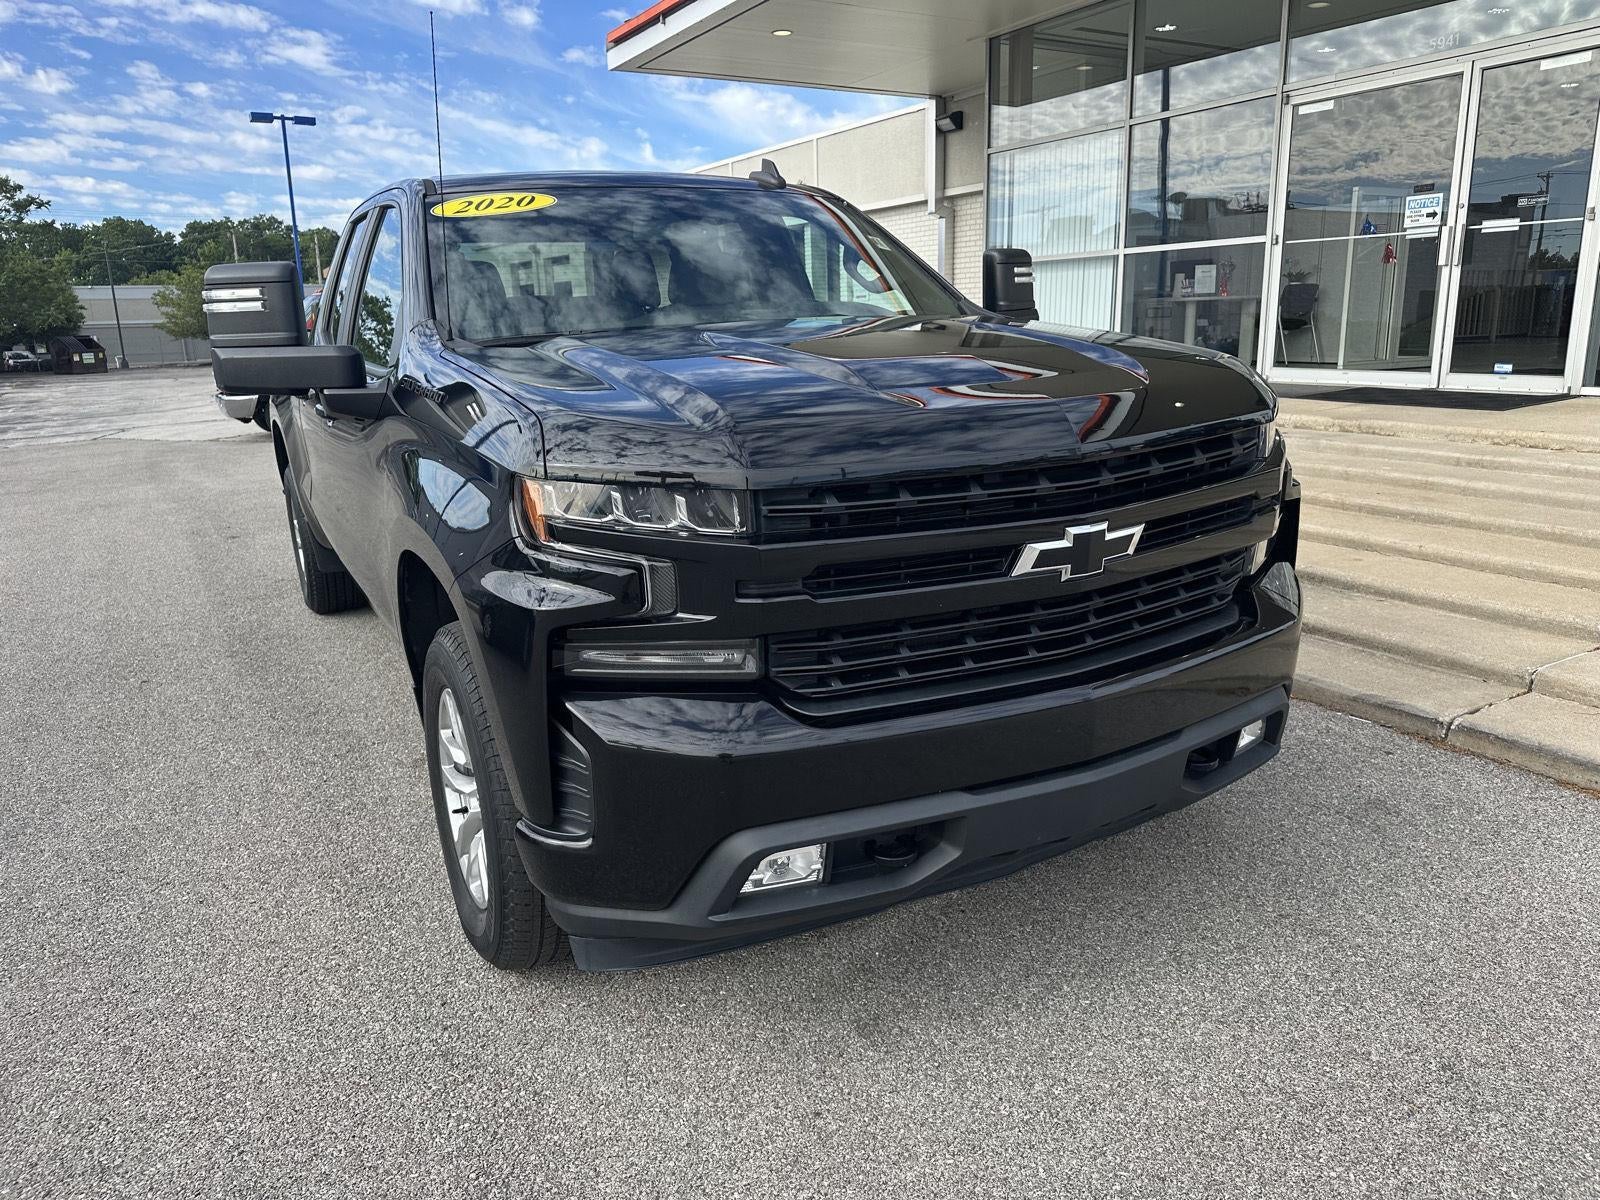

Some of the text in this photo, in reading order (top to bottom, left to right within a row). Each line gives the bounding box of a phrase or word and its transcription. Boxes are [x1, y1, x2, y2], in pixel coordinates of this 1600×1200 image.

[1429, 32, 1460, 49] 5941
[453, 195, 536, 214] 2020
[1408, 197, 1439, 209] NOTICE
[400, 377, 448, 404] SILVERADO
